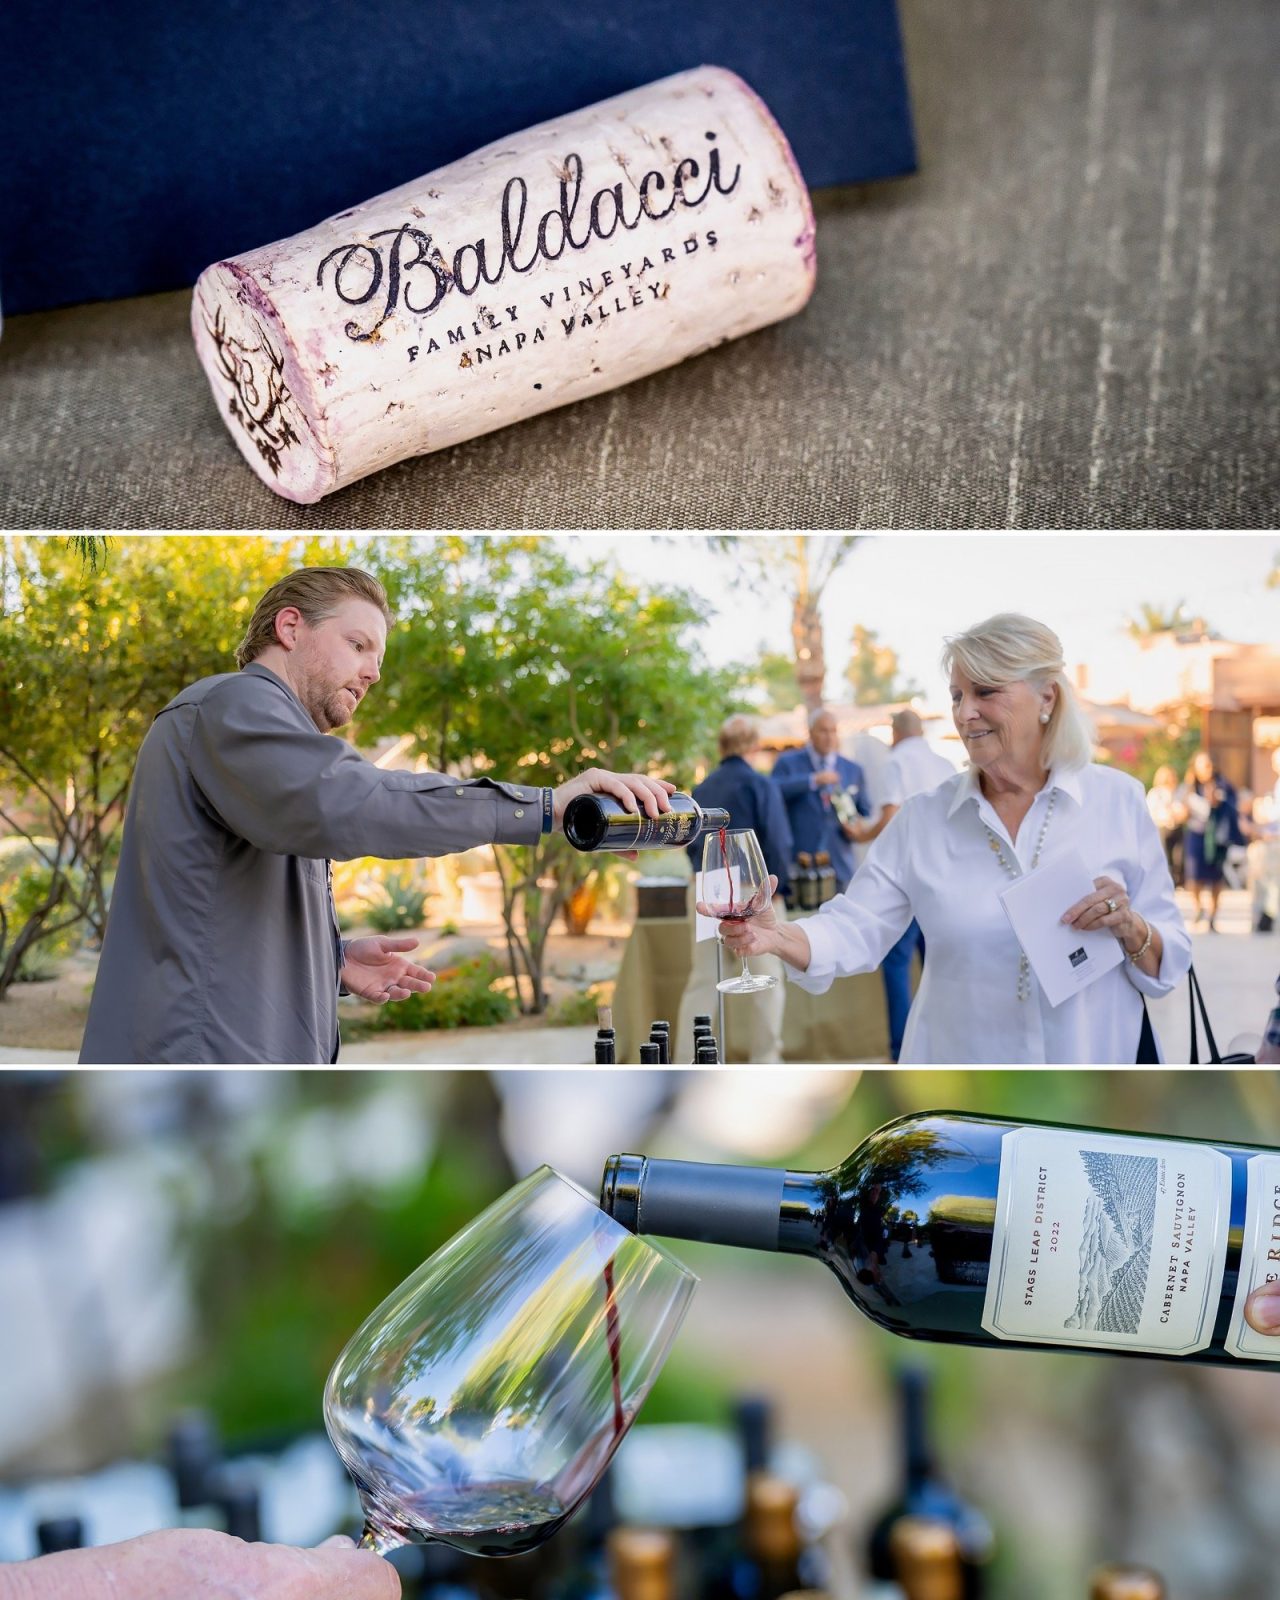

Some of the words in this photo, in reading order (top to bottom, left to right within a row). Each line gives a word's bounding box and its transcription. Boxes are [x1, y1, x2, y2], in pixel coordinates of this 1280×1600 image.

[317, 131, 741, 343] Baldacci
[407, 304, 518, 362] FAMILY
[541, 230, 718, 308] VINEYARDS
[476, 326, 545, 364] NAPA
[561, 281, 660, 338] VALLEY
[1034, 1166, 1048, 1224] DISTRICT
[1029, 1230, 1040, 1264] LEAP
[1049, 1221, 1060, 1253] 2022
[1159, 1255, 1179, 1324] CABERNET
[1171, 1172, 1186, 1249] SAUVIGNON
[1184, 1206, 1197, 1254] VALLEY
[1023, 1269, 1037, 1306] STAGS
[1178, 1260, 1191, 1293] NAPA
